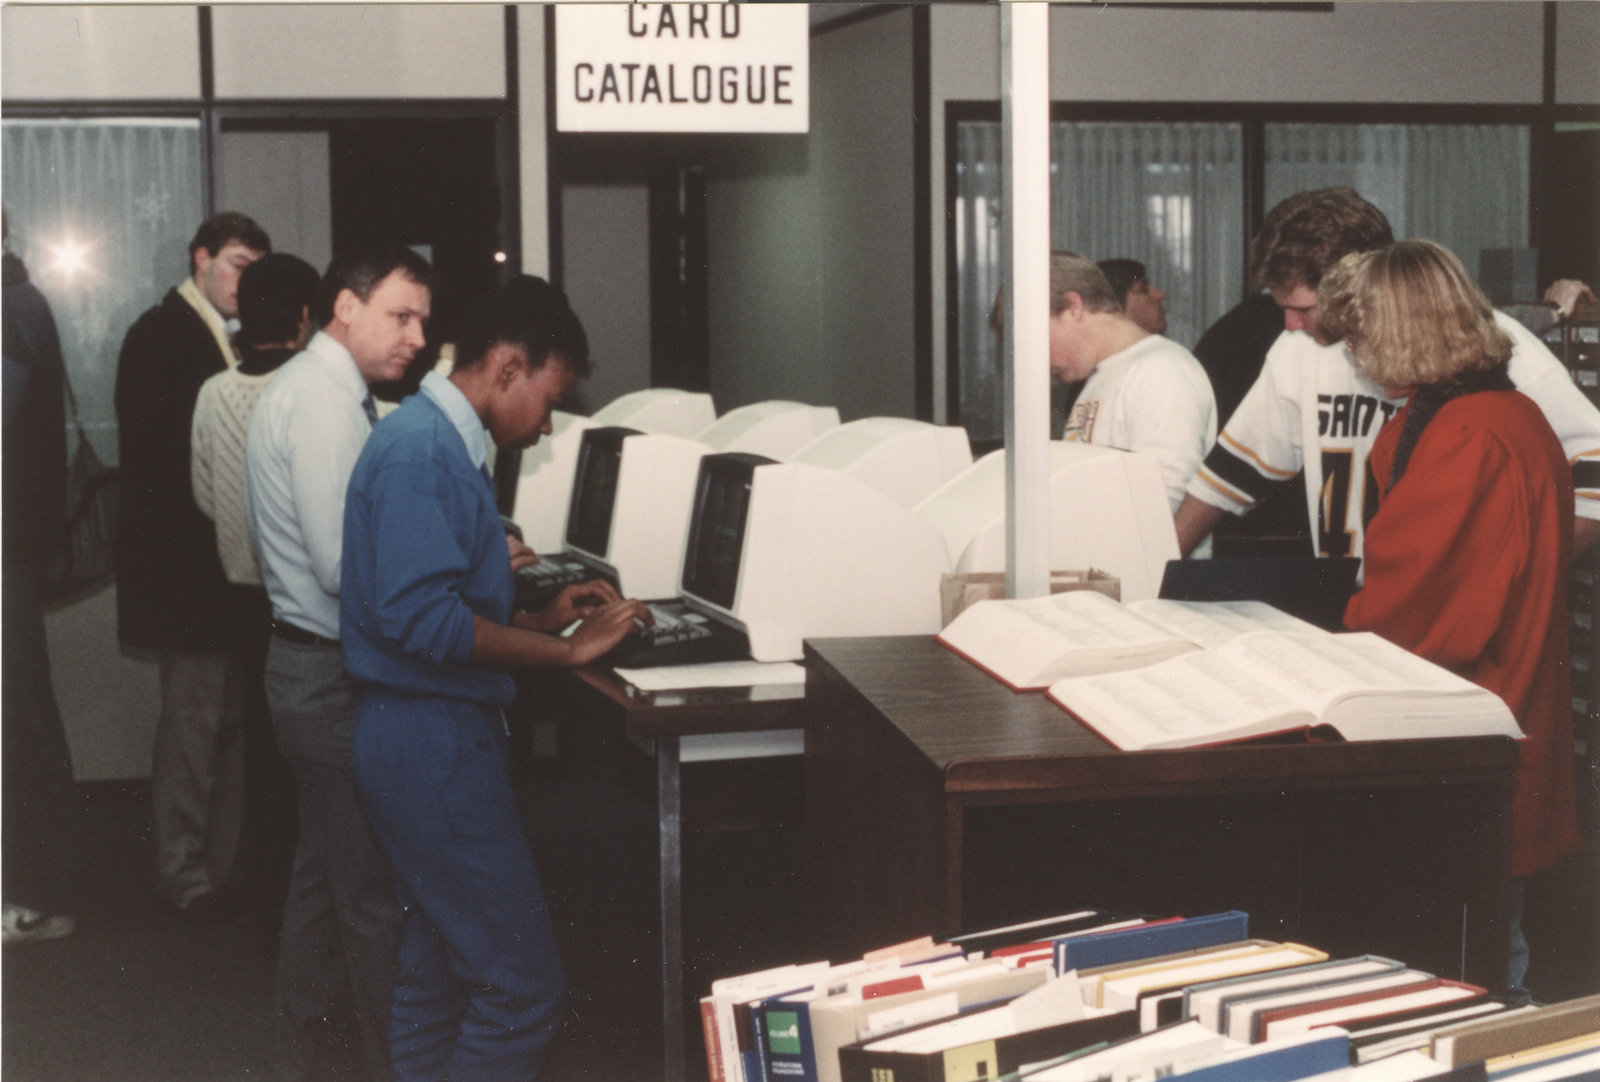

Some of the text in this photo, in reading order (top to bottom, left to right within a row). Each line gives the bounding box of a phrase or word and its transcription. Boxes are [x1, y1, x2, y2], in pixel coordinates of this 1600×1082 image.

[628, 3, 740, 38] CARD
[574, 63, 793, 104] CATALOGUE
[1317, 394, 1404, 437] SANT
